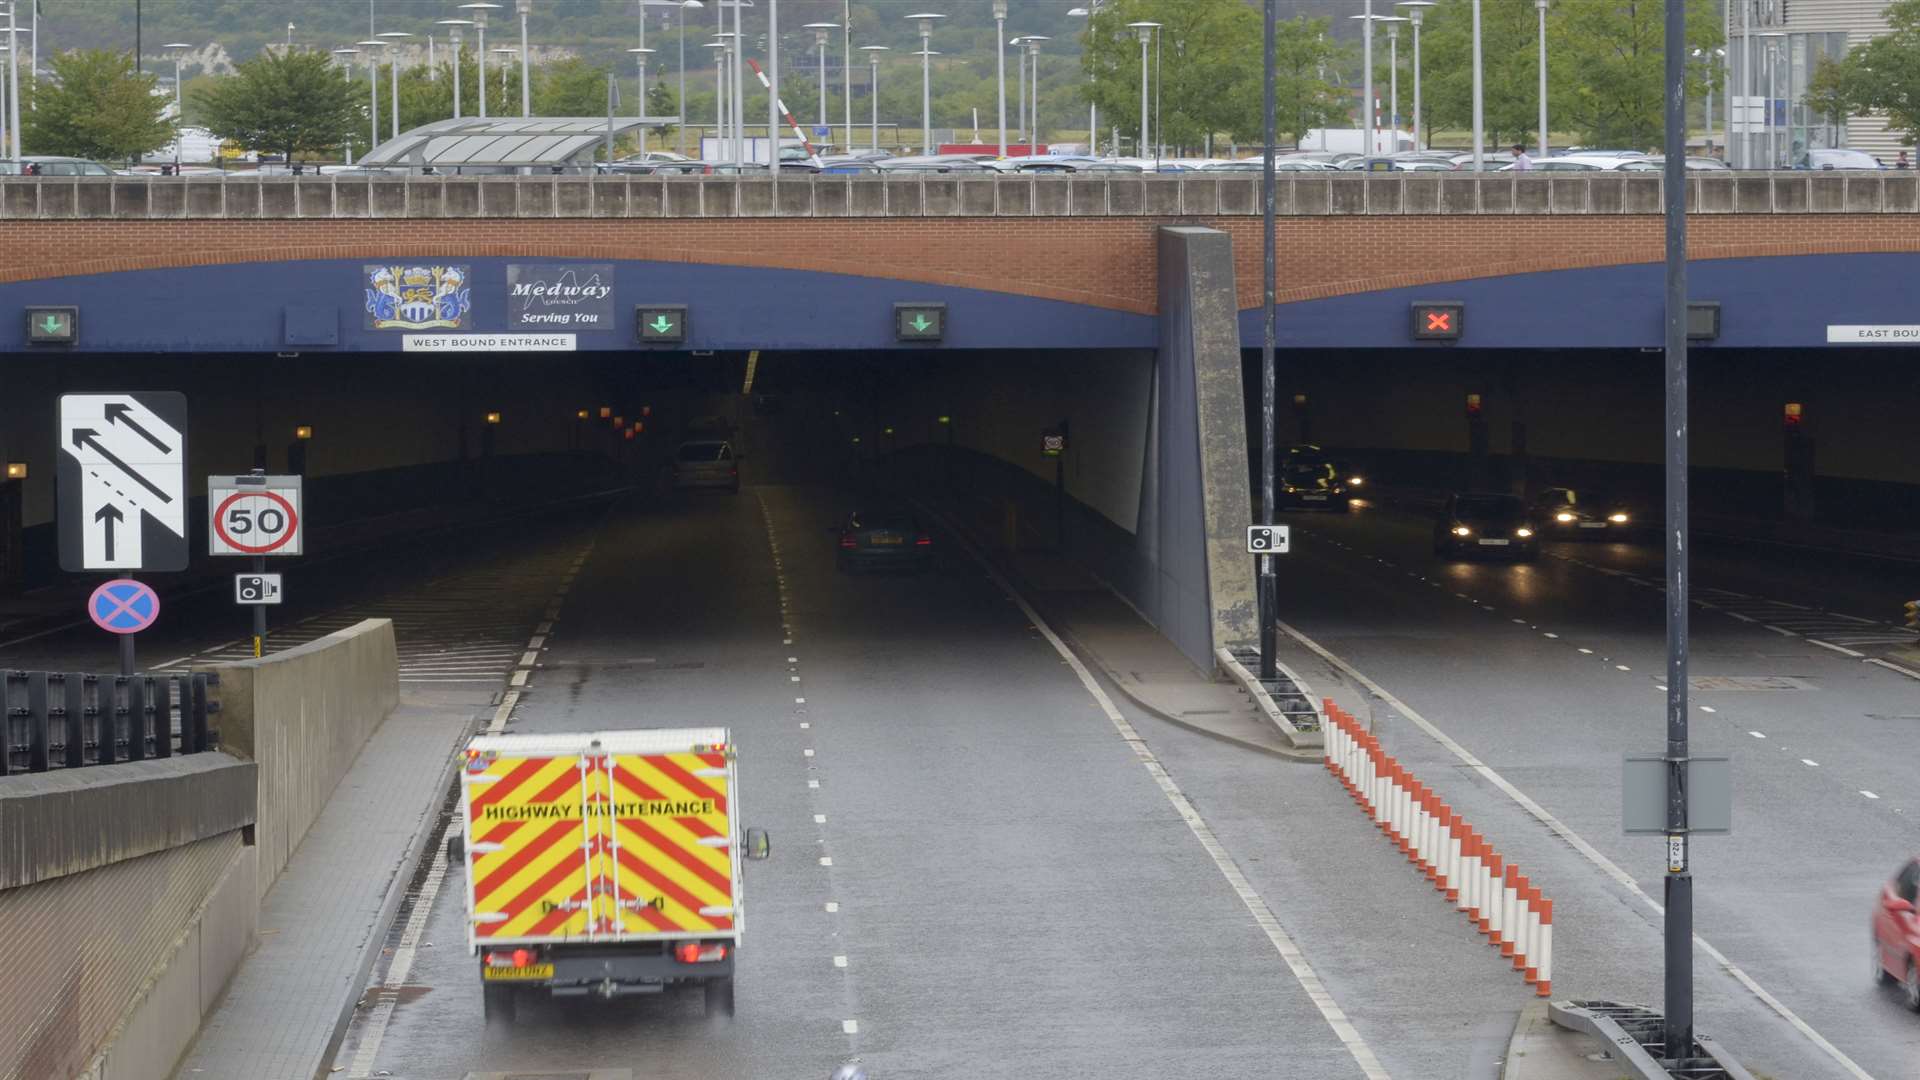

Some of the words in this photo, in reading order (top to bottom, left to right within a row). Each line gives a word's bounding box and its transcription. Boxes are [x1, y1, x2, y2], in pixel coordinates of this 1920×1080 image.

[511, 282, 611, 299] Medway
[521, 313, 570, 324] Serving
[573, 313, 599, 323] You
[1858, 329, 1888, 337] EAST
[1893, 329, 1919, 337] BOU
[413, 338, 447, 347] WEST
[451, 338, 496, 347] BOUND
[500, 338, 568, 346] ENTRANCE
[229, 509, 284, 534] 50
[485, 804, 572, 820] HIGHWAY
[579, 800, 713, 817] MAINTENANCE
